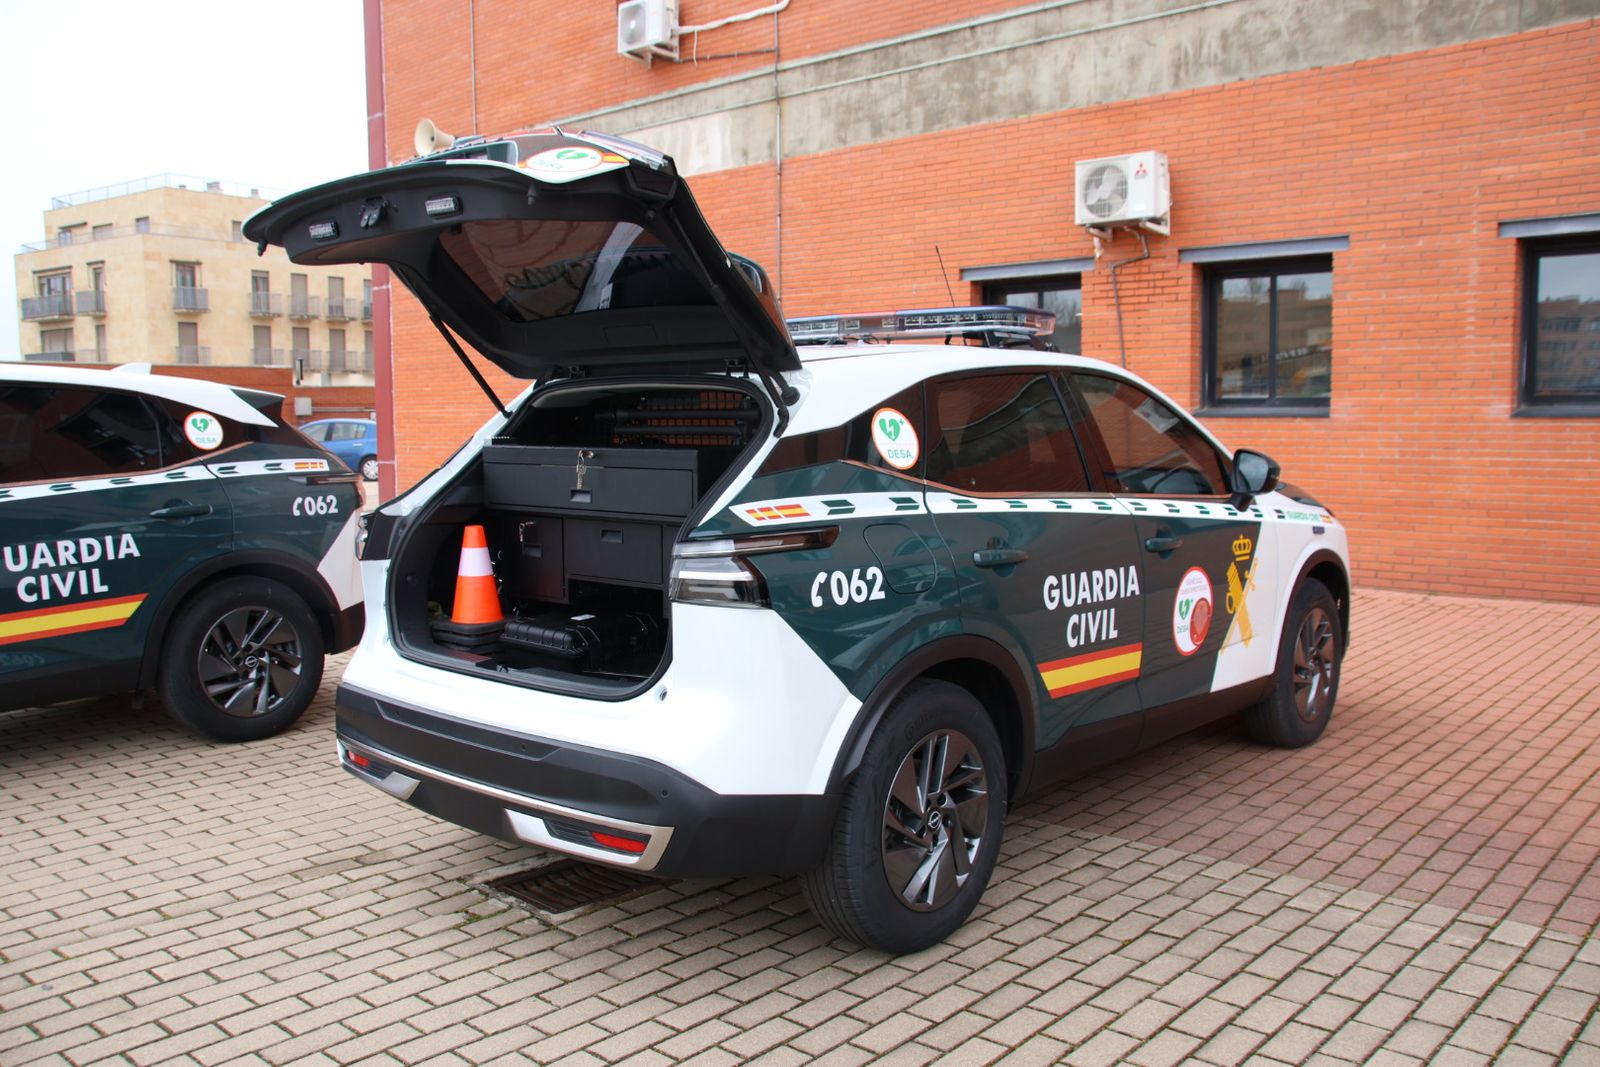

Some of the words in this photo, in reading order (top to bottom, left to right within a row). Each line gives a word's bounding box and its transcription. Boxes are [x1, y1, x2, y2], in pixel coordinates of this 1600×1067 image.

[887, 449, 912, 459] DESA
[304, 494, 339, 516] 062
[17, 568, 109, 603] CIVIL
[830, 566, 886, 606] 062
[1043, 565, 1140, 611] GUARDIA
[1066, 608, 1118, 648] CIVIL
